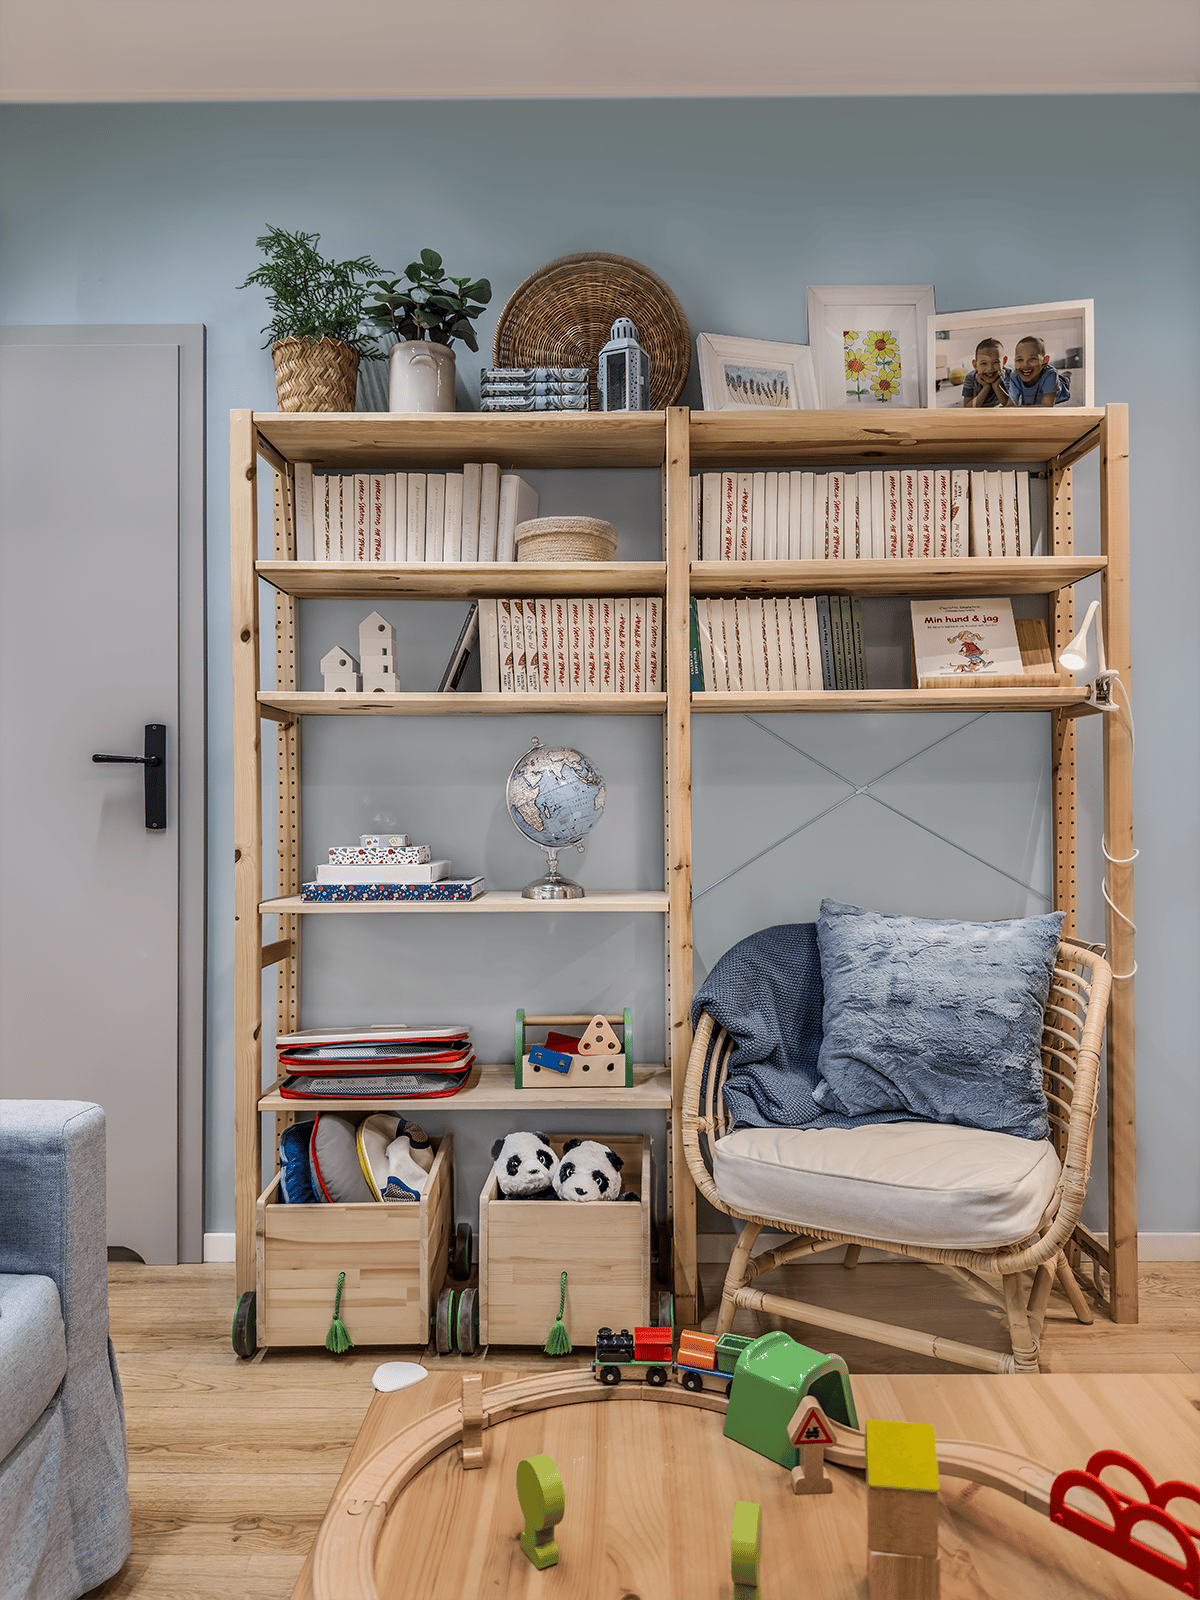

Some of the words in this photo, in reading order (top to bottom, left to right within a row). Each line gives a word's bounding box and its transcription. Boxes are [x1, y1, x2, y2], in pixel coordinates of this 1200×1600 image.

[924, 616, 942, 624] Min
[945, 615, 969, 623] hund
[972, 614, 979, 622] &
[982, 614, 999, 624] jag
